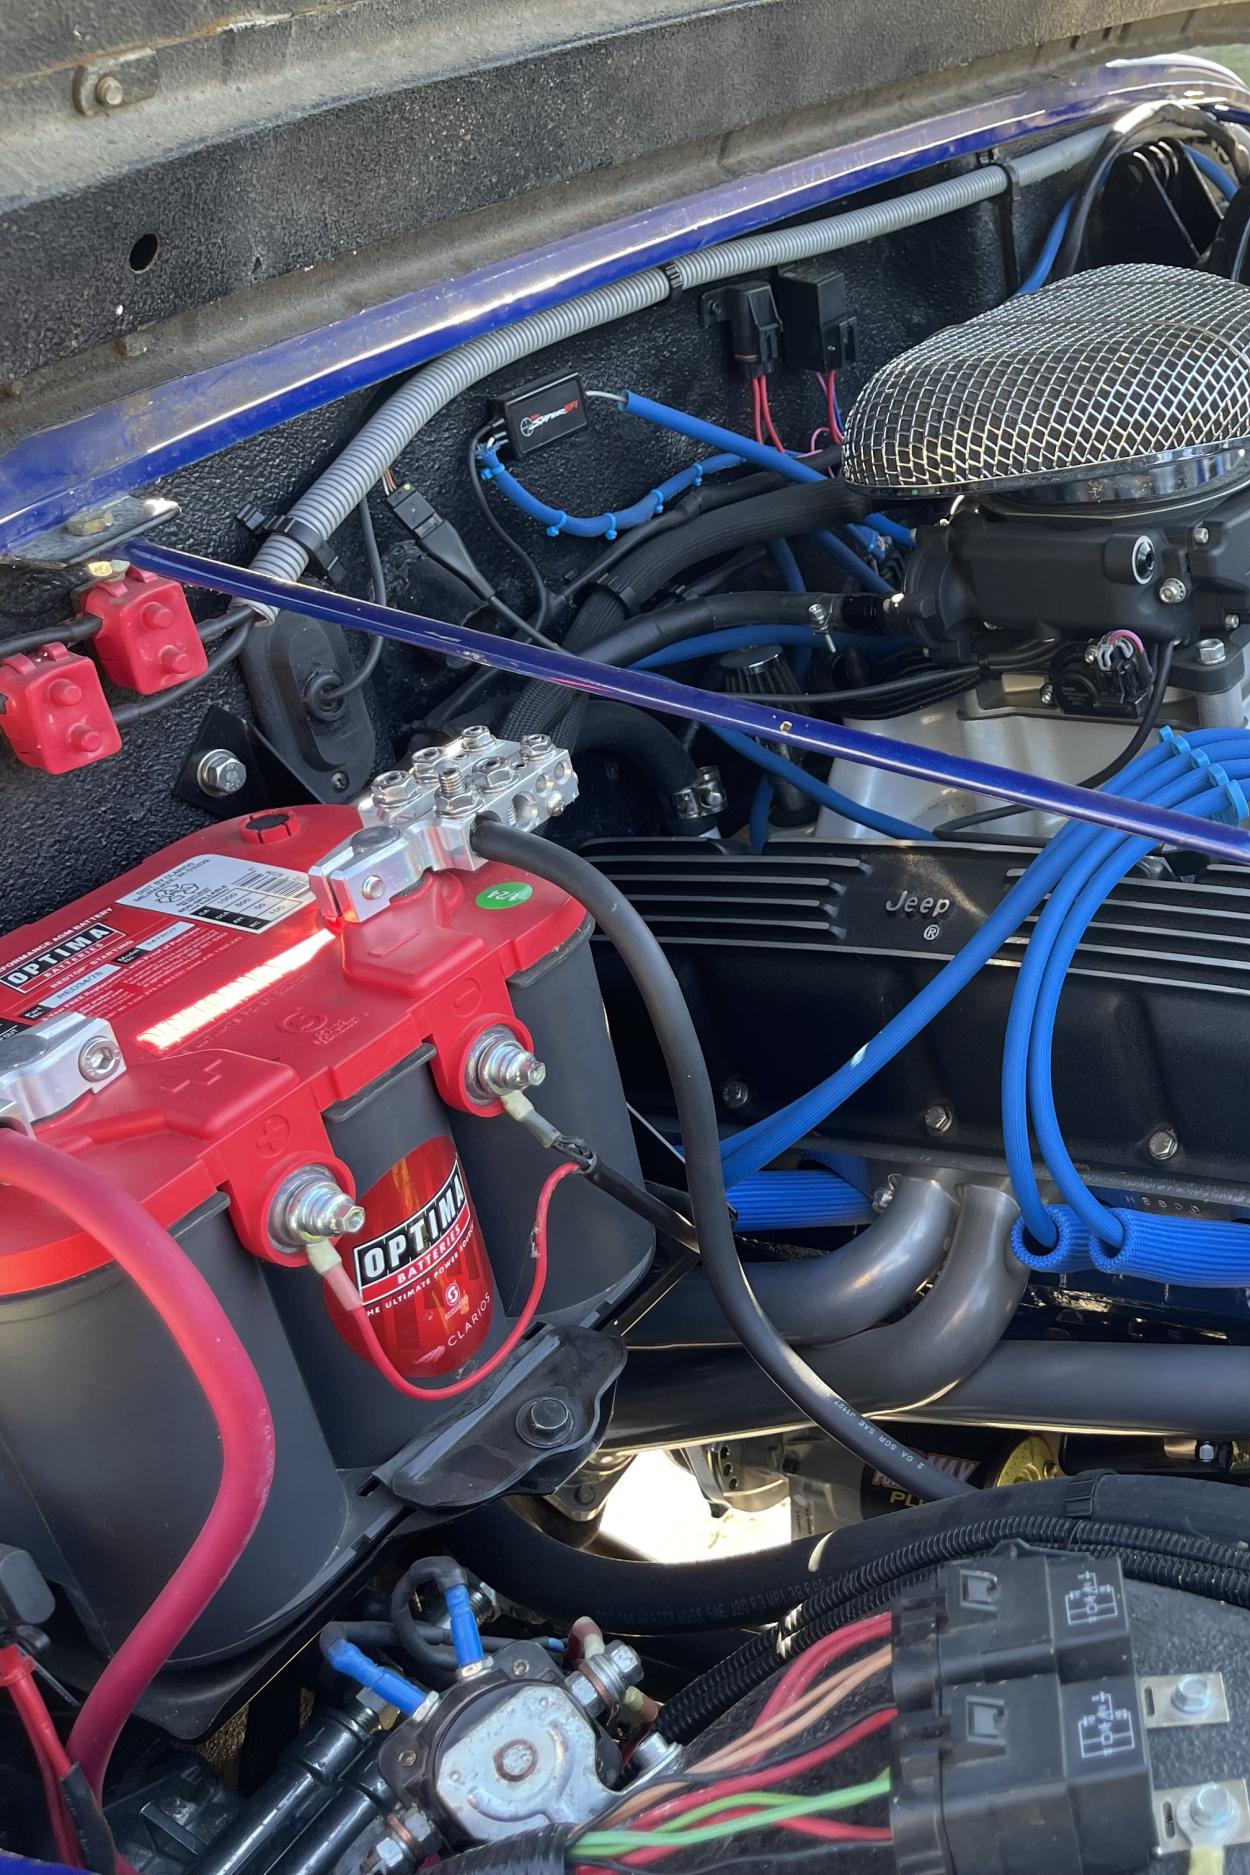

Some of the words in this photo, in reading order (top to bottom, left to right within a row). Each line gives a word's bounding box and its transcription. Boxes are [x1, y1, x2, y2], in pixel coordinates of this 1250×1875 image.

[885, 890, 950, 917] Jeep
[0, 939, 52, 973] FORMANCE
[73, 906, 114, 927] BATTERY
[7, 926, 112, 984] OPTIMA
[89, 939, 135, 966] STARTING
[44, 943, 105, 979] BATTERIES
[363, 1173, 466, 1279] OPTIMA
[366, 1305, 382, 1317] HE
[383, 1277, 432, 1311] ULTIMATE
[433, 1252, 461, 1278] POWER
[459, 1220, 476, 1252] SOURCE
[396, 1222, 462, 1285] BATTERIES
[447, 1291, 491, 1347] CLARIOS
[832, 1399, 857, 1418] J1127
[857, 1420, 876, 1435] SAE
[877, 1434, 899, 1452] SGR
[916, 1462, 926, 1470] 2
